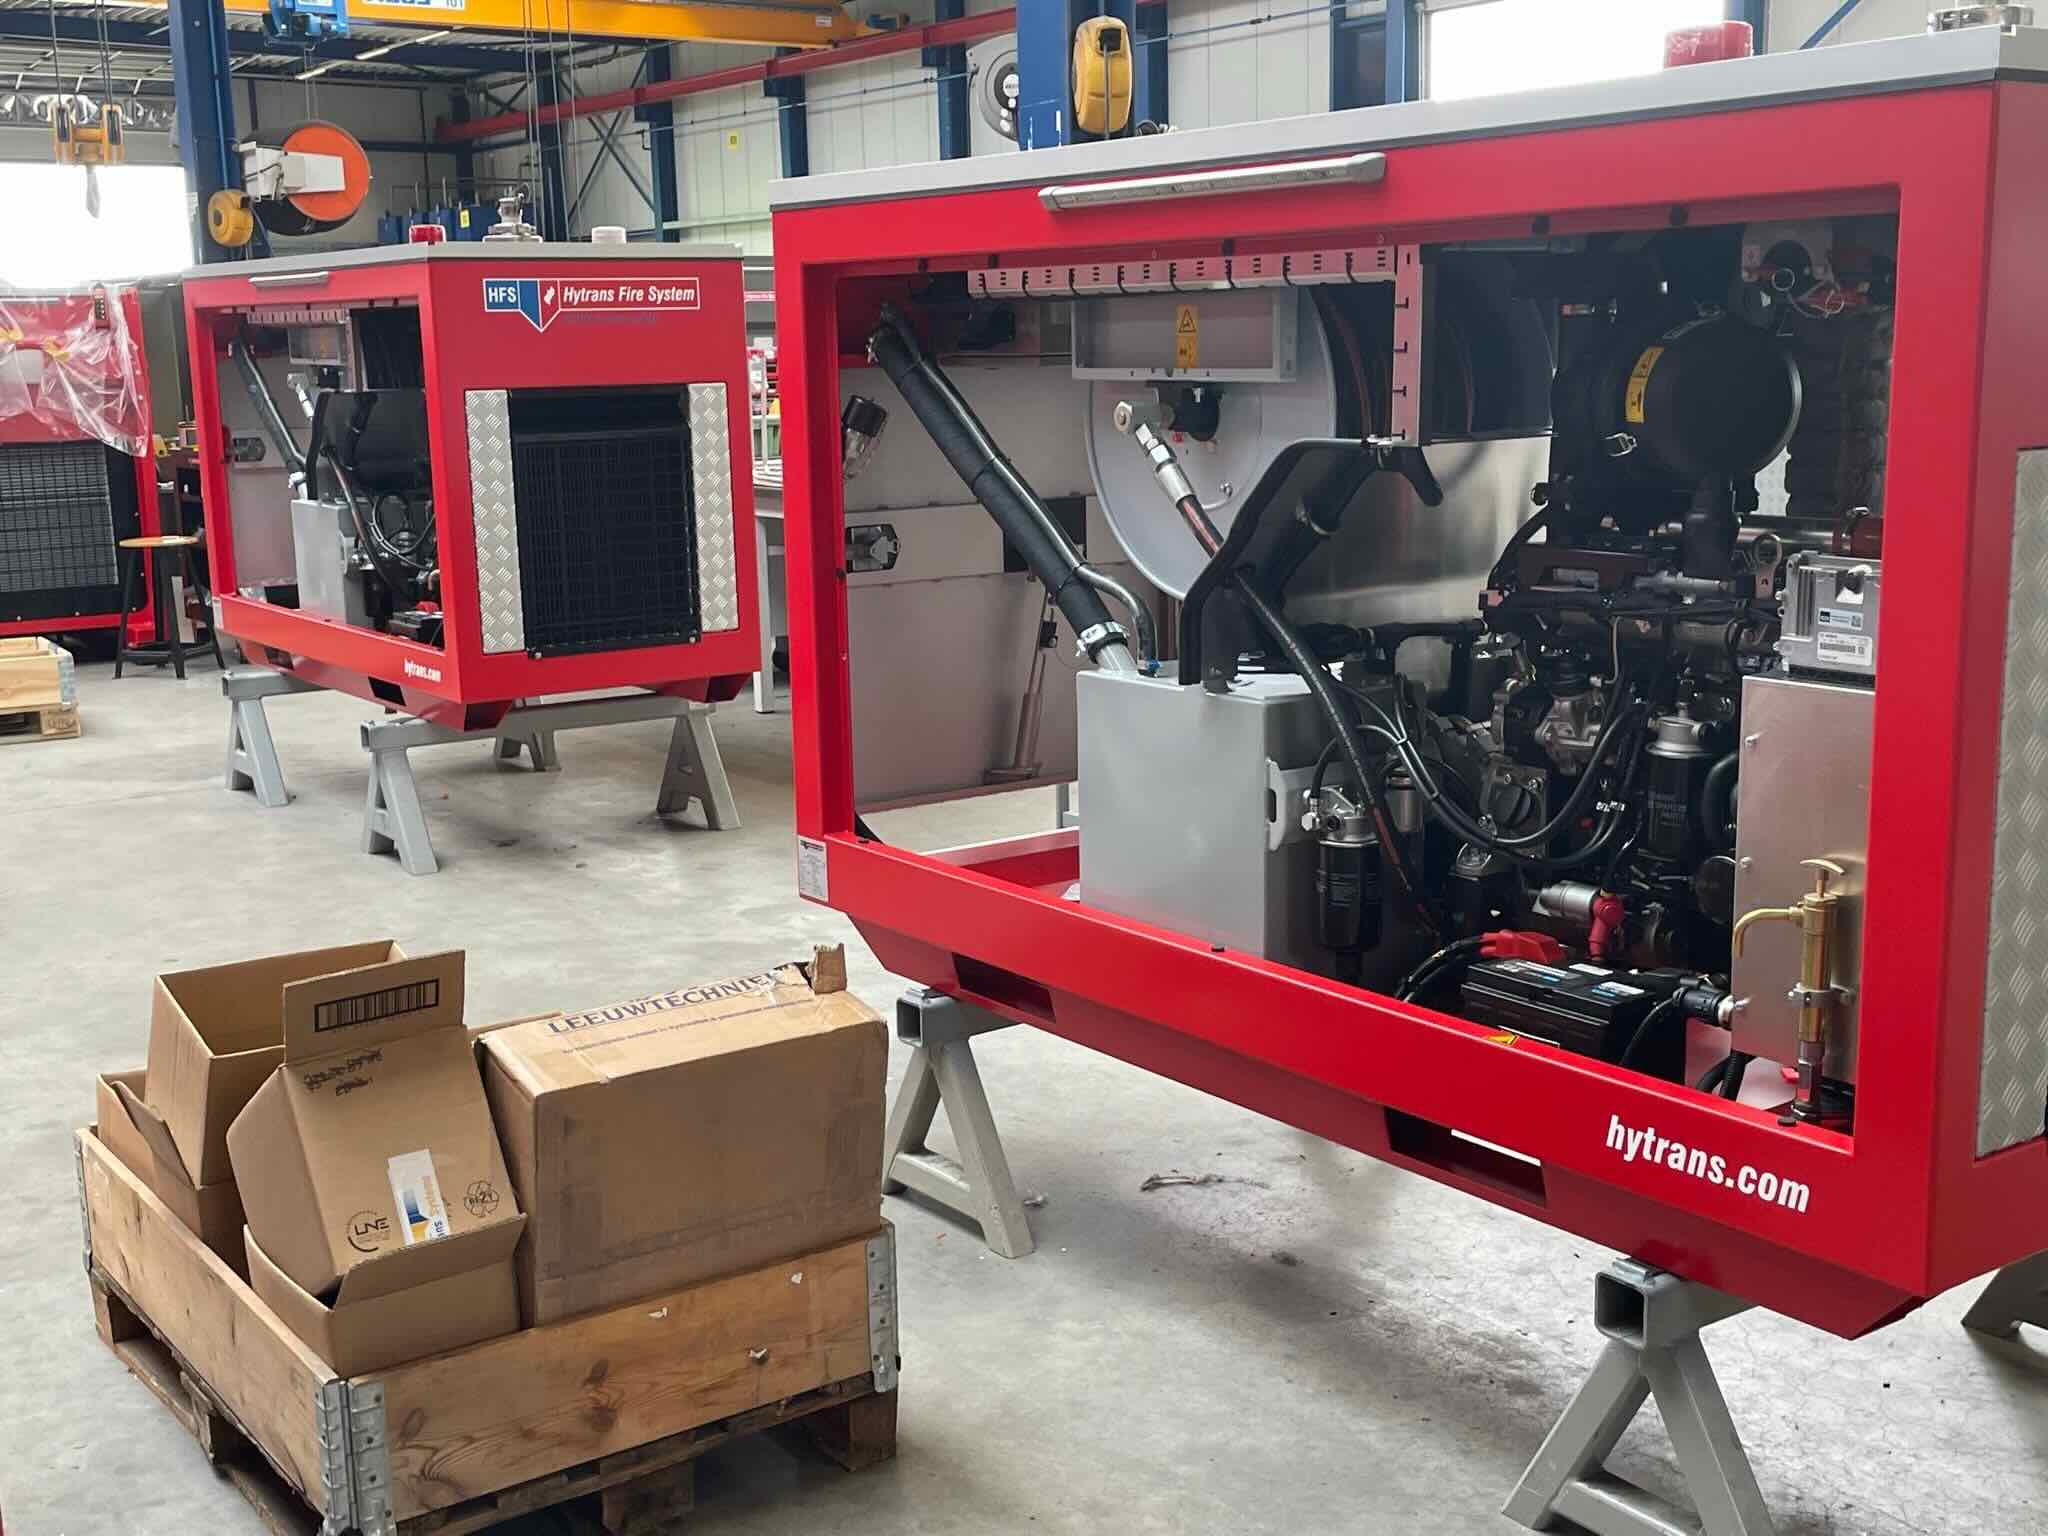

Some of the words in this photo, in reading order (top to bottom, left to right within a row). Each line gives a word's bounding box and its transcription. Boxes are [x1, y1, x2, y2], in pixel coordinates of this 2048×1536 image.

[488, 286, 518, 304] HFS
[563, 286, 615, 306] Hytrans
[618, 286, 644, 303] Fire
[648, 285, 695, 305] System
[548, 970, 776, 1034] LEEUWTECHNIE
[1605, 1114, 1811, 1213] hytrans.com
